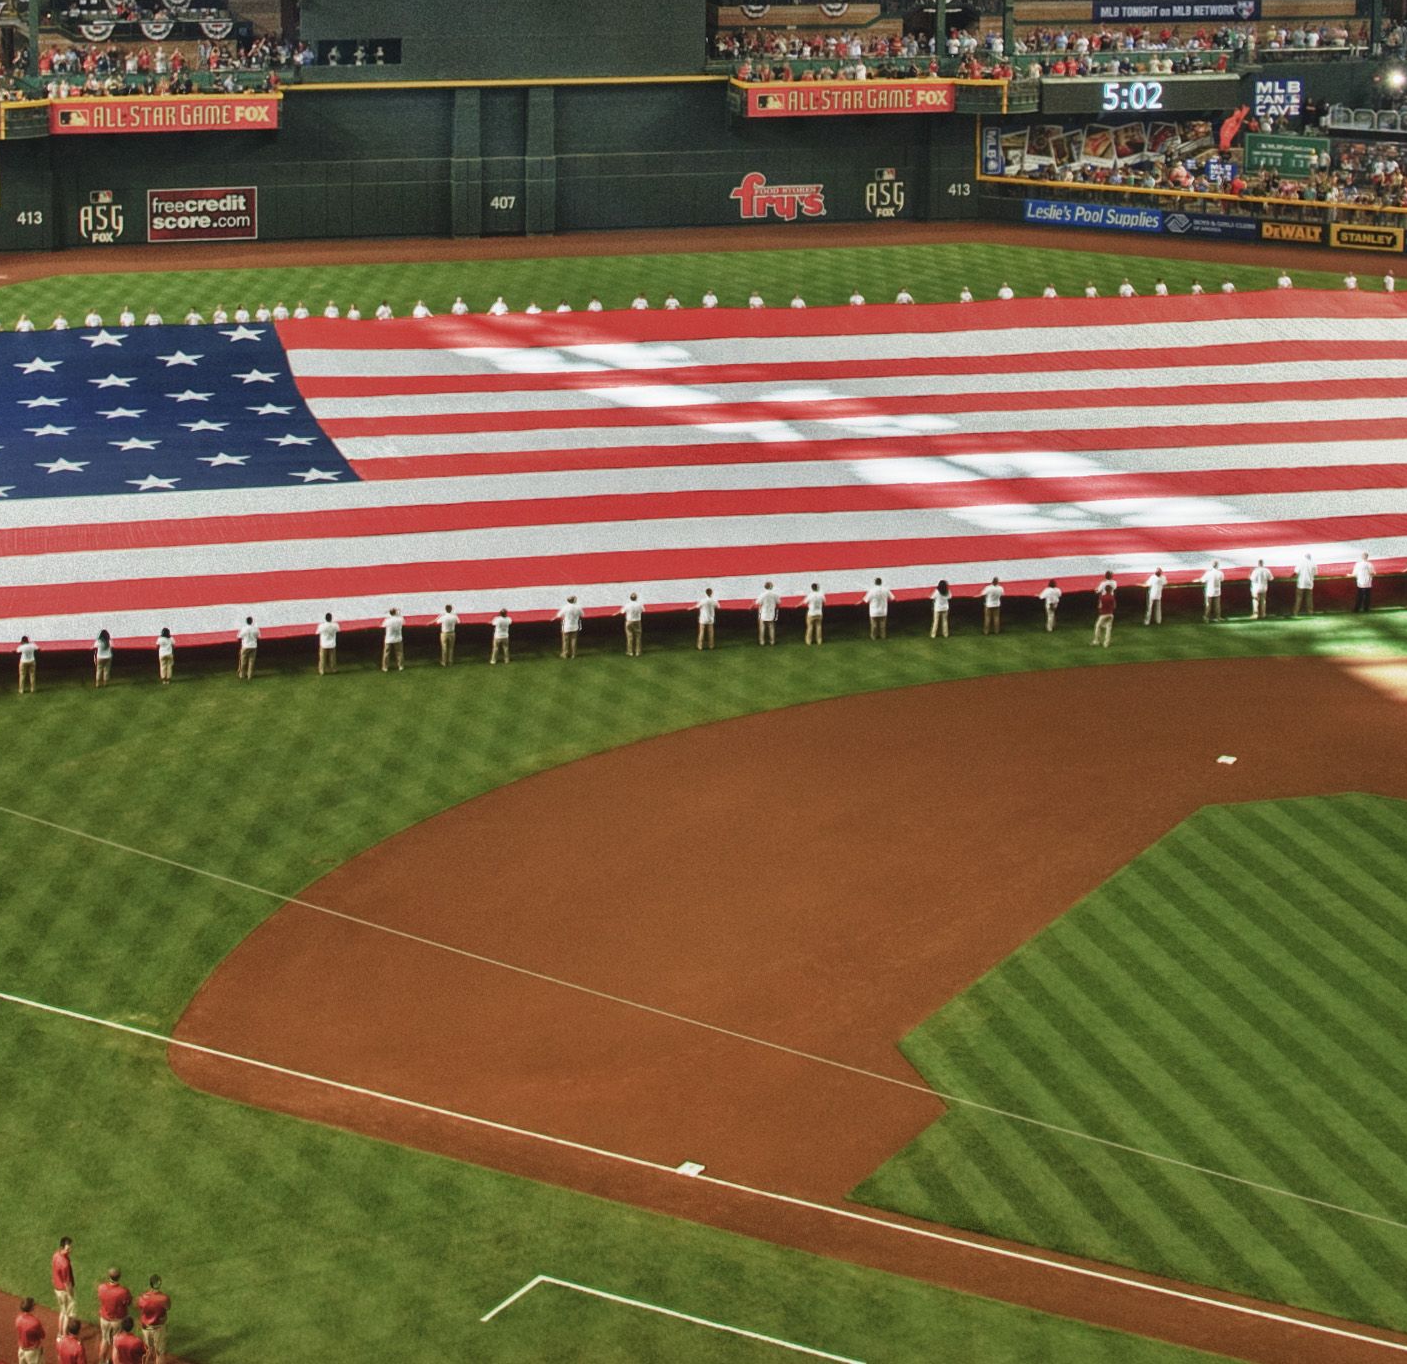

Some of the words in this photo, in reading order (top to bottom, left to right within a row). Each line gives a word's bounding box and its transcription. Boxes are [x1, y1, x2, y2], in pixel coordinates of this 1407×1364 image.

[1100, 6, 1119, 17] MLB
[1121, 6, 1159, 17] TONIGHT
[1172, 6, 1192, 16] MLB
[1194, 4, 1235, 16] NETWORK
[1256, 81, 1301, 94] MLB
[788, 91, 818, 111] ALL
[824, 90, 863, 110] STAR
[867, 89, 912, 109] GAME
[916, 90, 948, 105] FOX
[1102, 82, 1163, 111] 5:02
[1255, 94, 1284, 104] FAN
[93, 107, 127, 128] ALL
[130, 105, 176, 127] STAR
[180, 104, 232, 125] GAME
[234, 105, 270, 123] FOX
[1255, 106, 1300, 116] CAVE
[490, 196, 516, 210] 407
[730, 171, 825, 221] fry's
[865, 181, 904, 214] ASG
[948, 183, 971, 196] 413
[152, 195, 247, 213] freecredit
[16, 211, 43, 225] 413
[876, 207, 896, 217] FOX
[1026, 202, 1072, 222] Leslie's
[1074, 206, 1104, 223] Pool
[1107, 210, 1160, 230] Supplies
[79, 205, 124, 239] ASG
[152, 214, 251, 230] score.com
[92, 231, 114, 243] FOX
[1340, 232, 1394, 246] STANLEY
